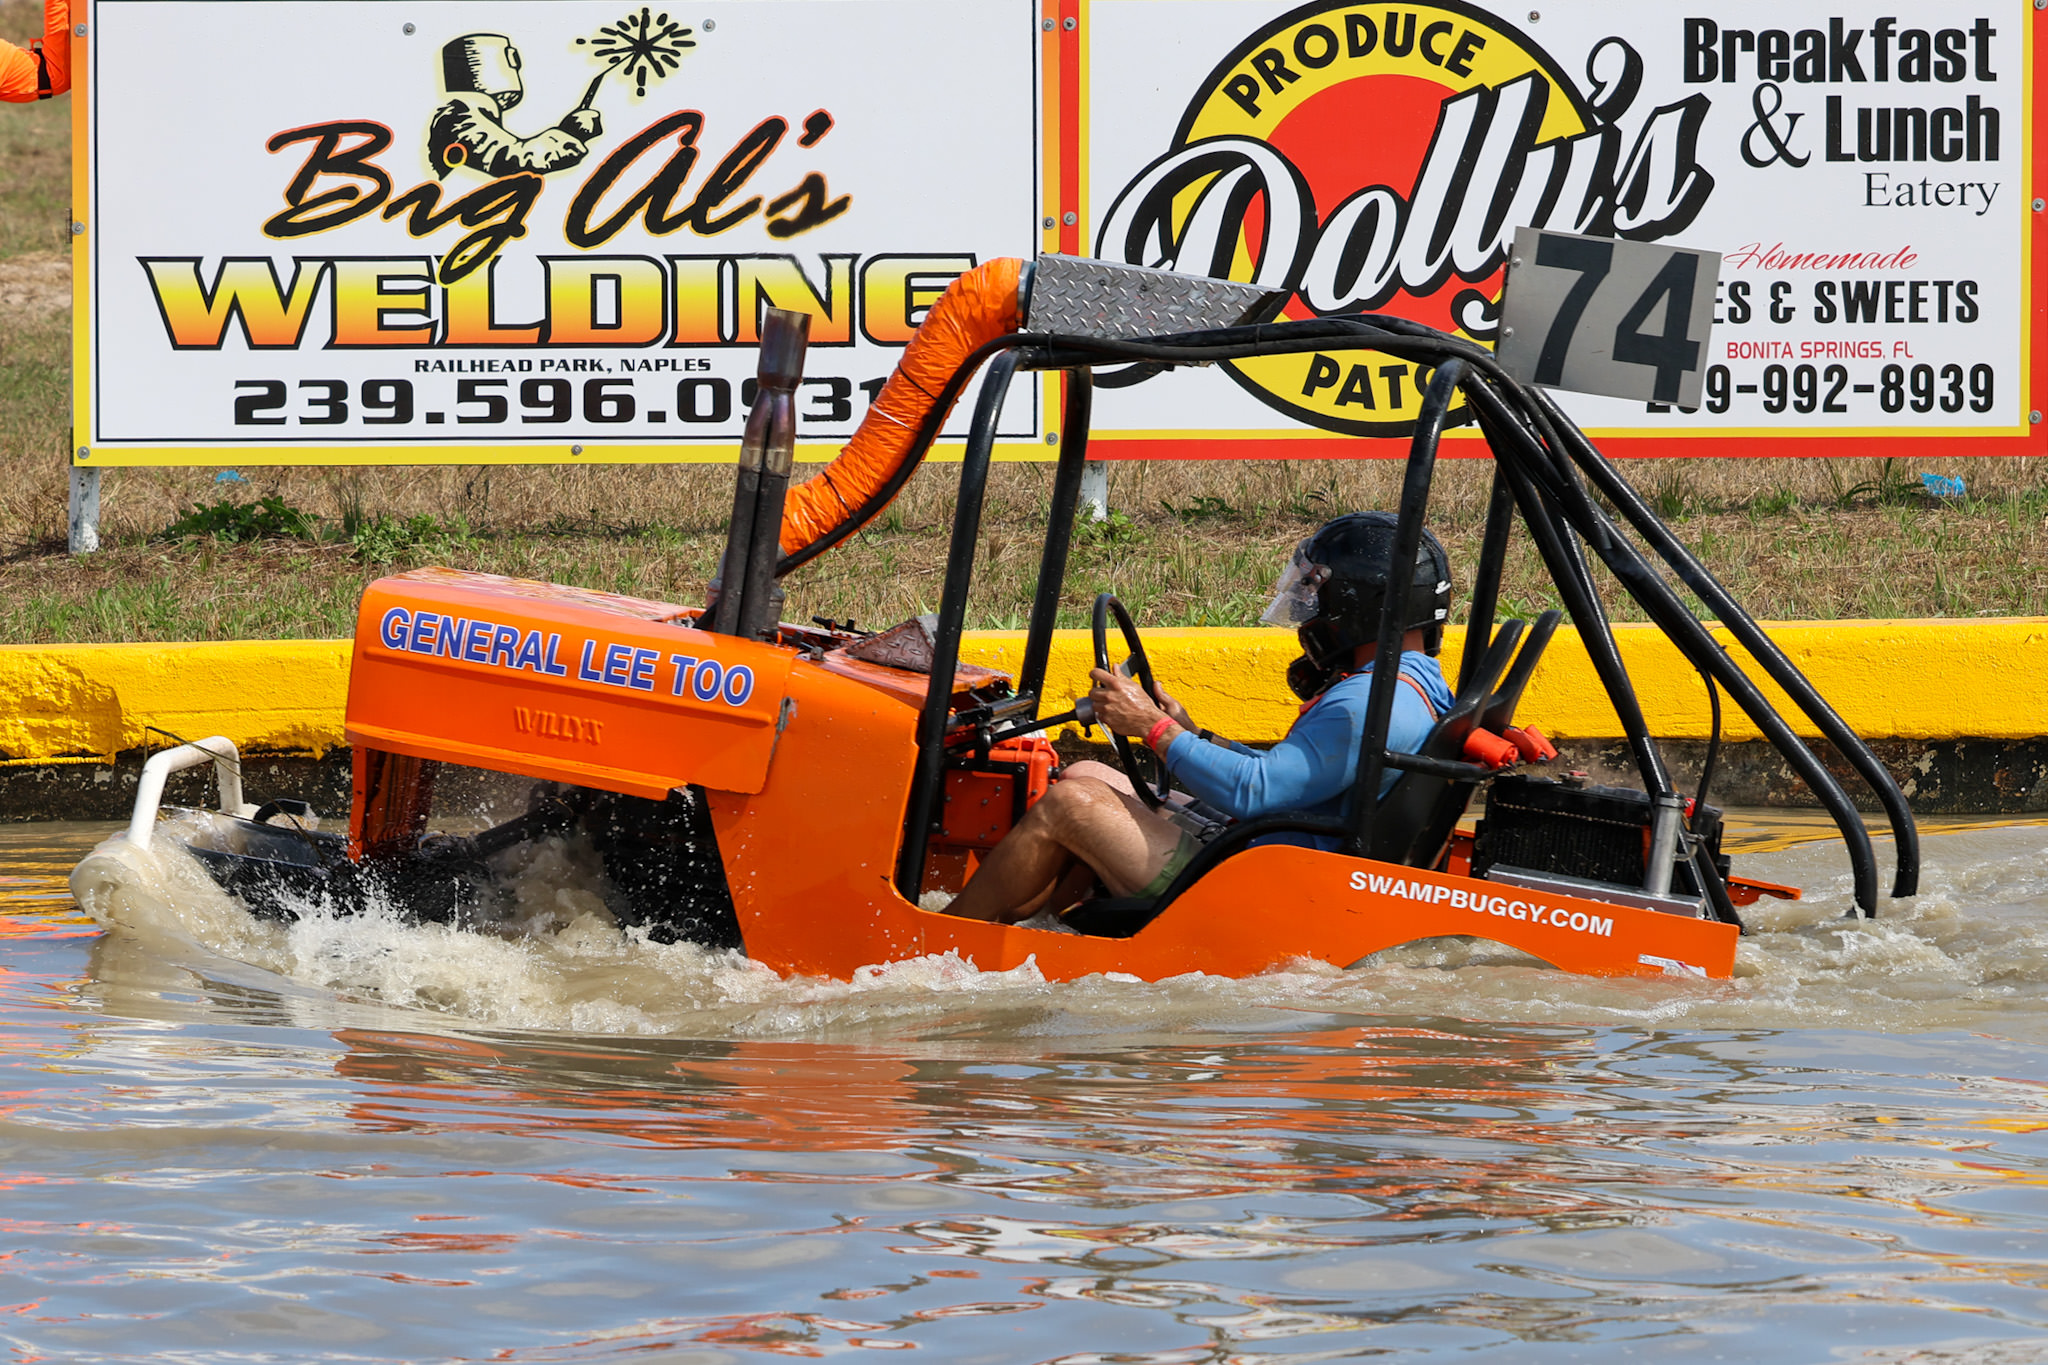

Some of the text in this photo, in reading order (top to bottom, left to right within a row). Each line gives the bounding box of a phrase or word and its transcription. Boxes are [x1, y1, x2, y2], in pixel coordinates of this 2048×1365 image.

[1222, 12, 1487, 118] PRODUCE
[1683, 18, 1997, 83] Breakfast
[1740, 82, 1999, 168] & Lunch
[261, 108, 853, 288] Big Al's
[1095, 36, 1714, 388] Dolly's
[1862, 172, 2001, 216] Eatery
[1723, 242, 1919, 270] Homemade
[135, 252, 977, 349] WELDING
[1535, 233, 1701, 404] 74
[1769, 281, 1796, 324] &
[1814, 280, 1979, 324] SWEETS
[414, 357, 711, 374] RAILHEAD PARK, NAPLES
[1727, 341, 1914, 359] BONITA SPRINGS, FL
[233, 377, 888, 425] 239.596.03
[1646, 363, 1994, 414] 9-992-8939
[380, 607, 754, 707] GENERAL LEE TOO
[1349, 871, 1615, 937] SWAMPBUGGY.COM
